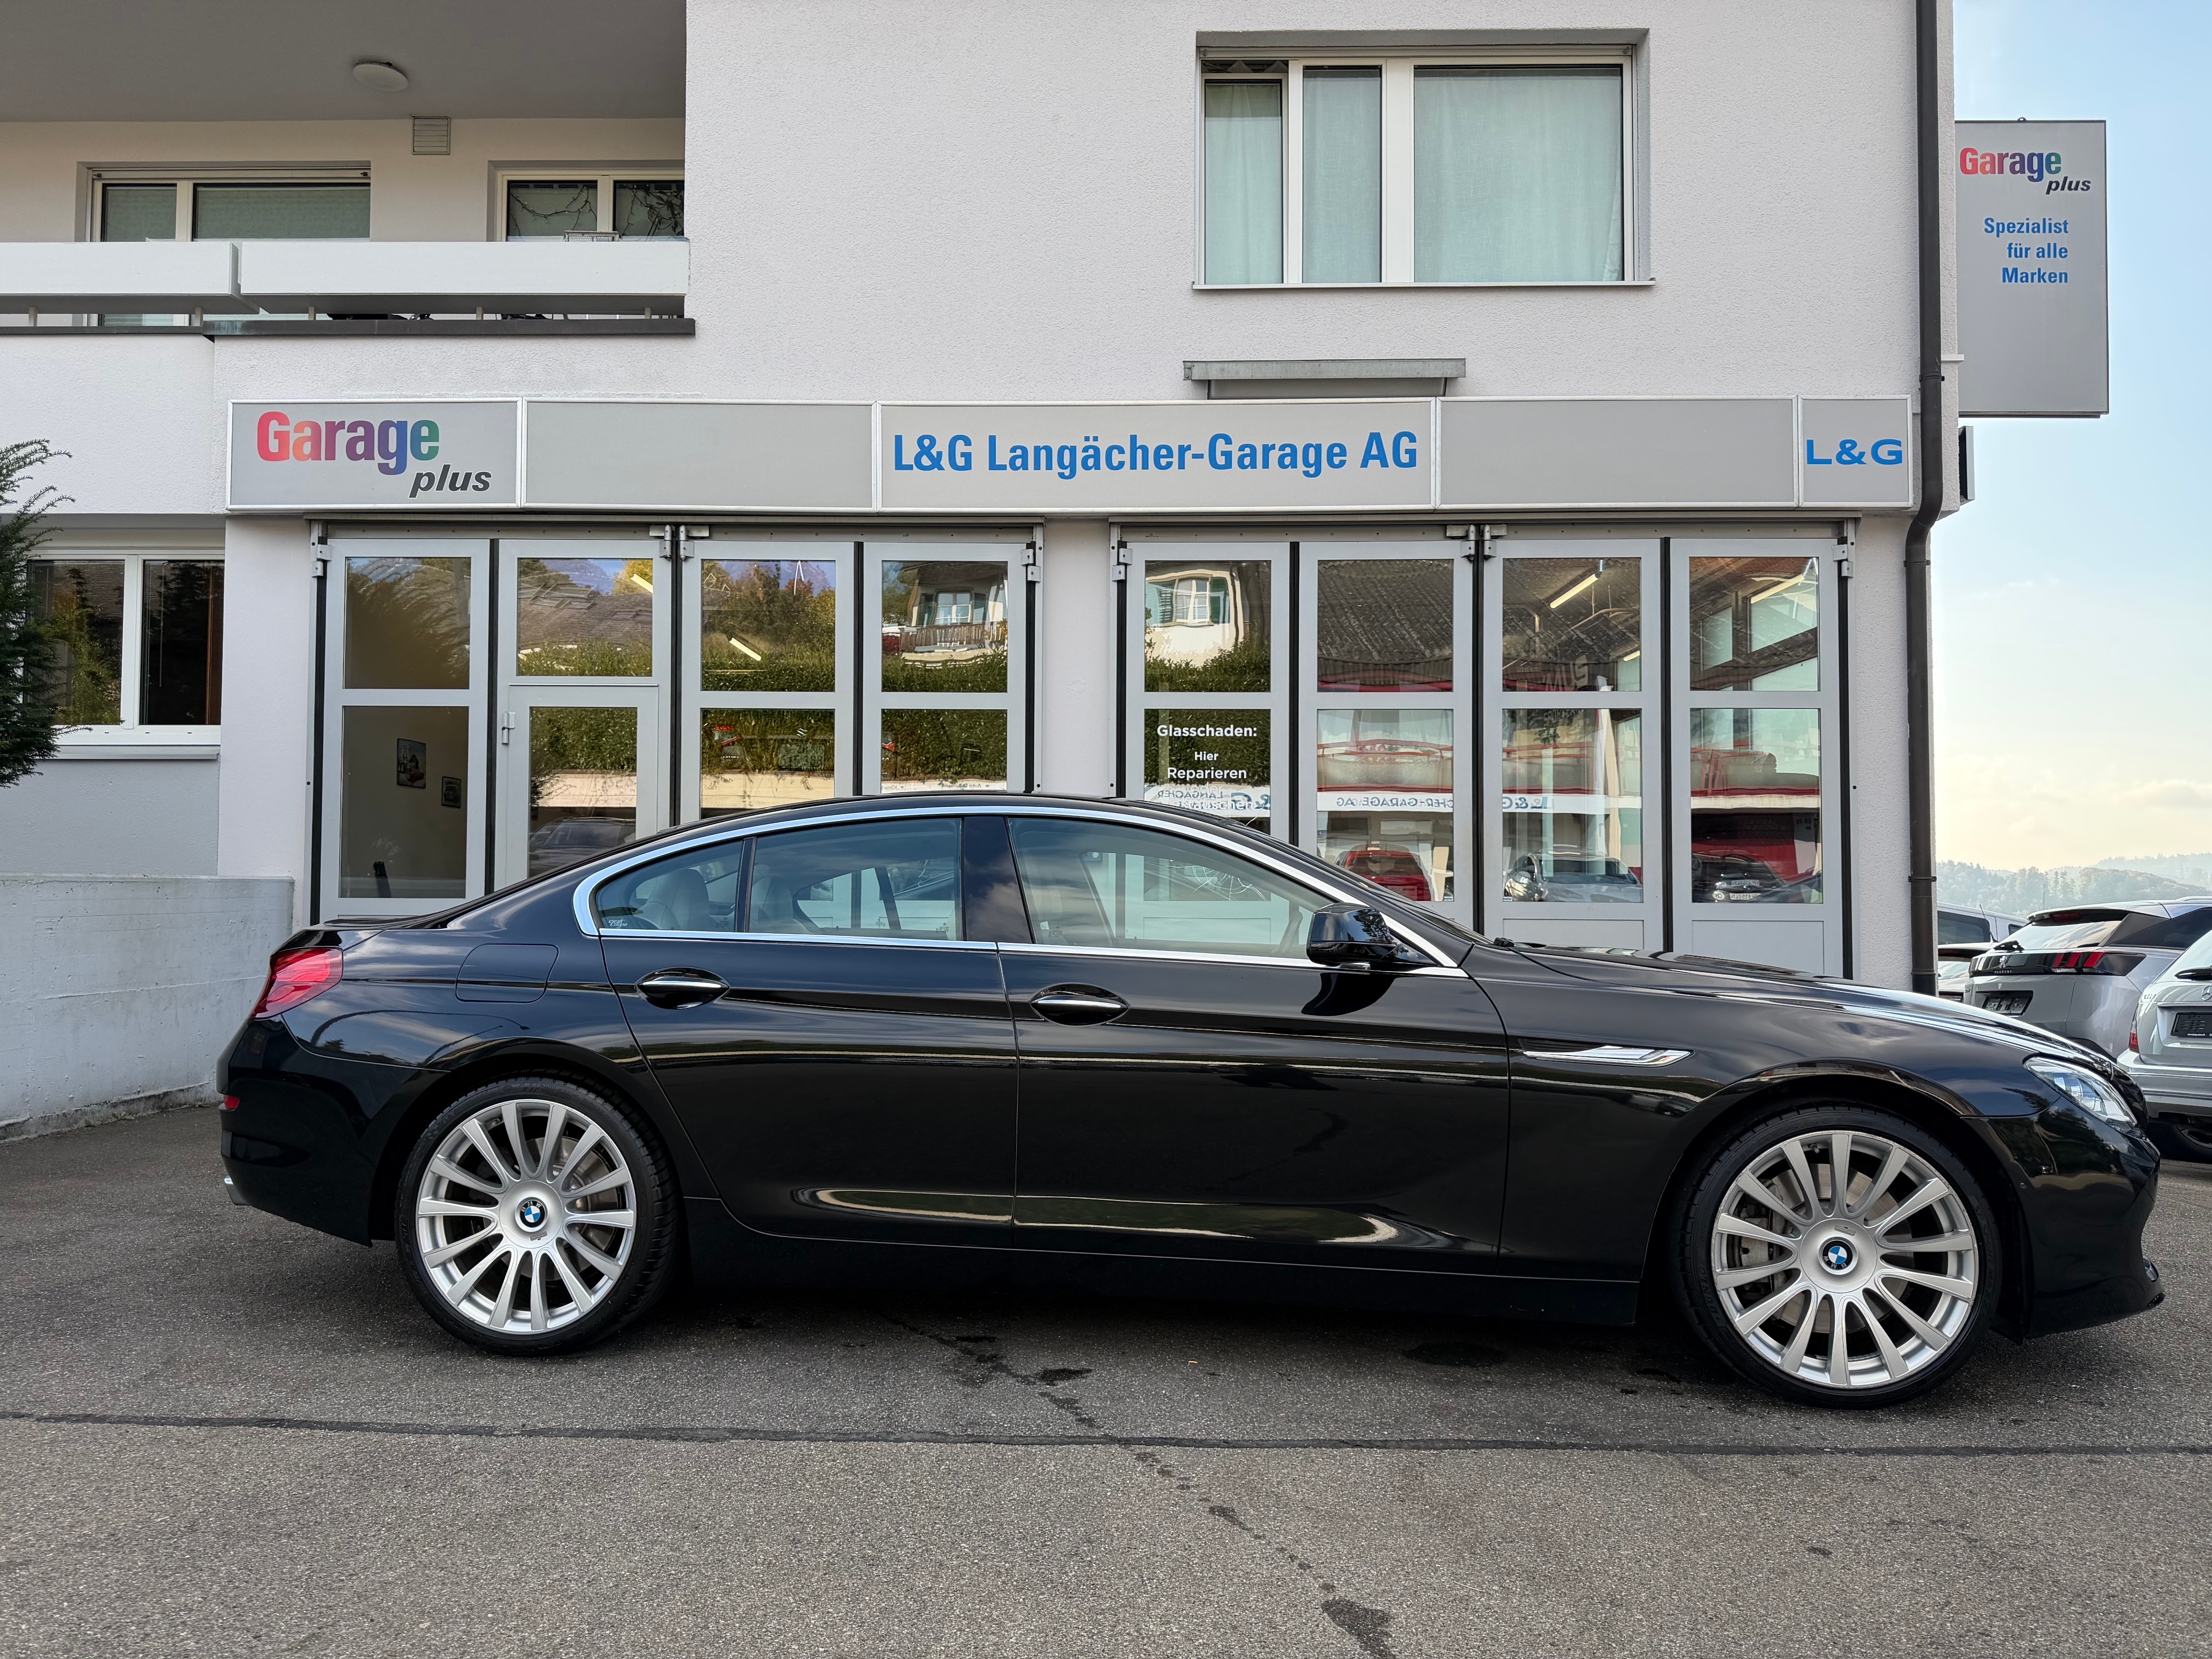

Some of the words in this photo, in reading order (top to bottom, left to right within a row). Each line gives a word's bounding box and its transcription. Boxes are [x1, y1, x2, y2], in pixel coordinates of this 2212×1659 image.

[1960, 148, 2061, 182] Garage
[2045, 176, 2091, 194] plus
[1984, 217, 2068, 237] Spezialist
[2007, 242, 2031, 259] für
[2036, 243, 2068, 259] alle
[2002, 267, 2068, 283] Marken
[257, 412, 439, 475] Garage
[1807, 439, 1902, 465] L&G
[894, 434, 972, 471] L&G
[988, 433, 1347, 480] Langächer-Garage
[1360, 431, 1417, 468] AG
[409, 464, 492, 498] plus
[1157, 725, 1257, 737] Glasschaden:
[1195, 751, 1219, 761] Hier
[1167, 767, 1247, 781] Reparieren
[1190, 782, 1224, 794] oder
[521, 1201, 543, 1212] BMW
[1823, 1256, 1847, 1269] BMW
